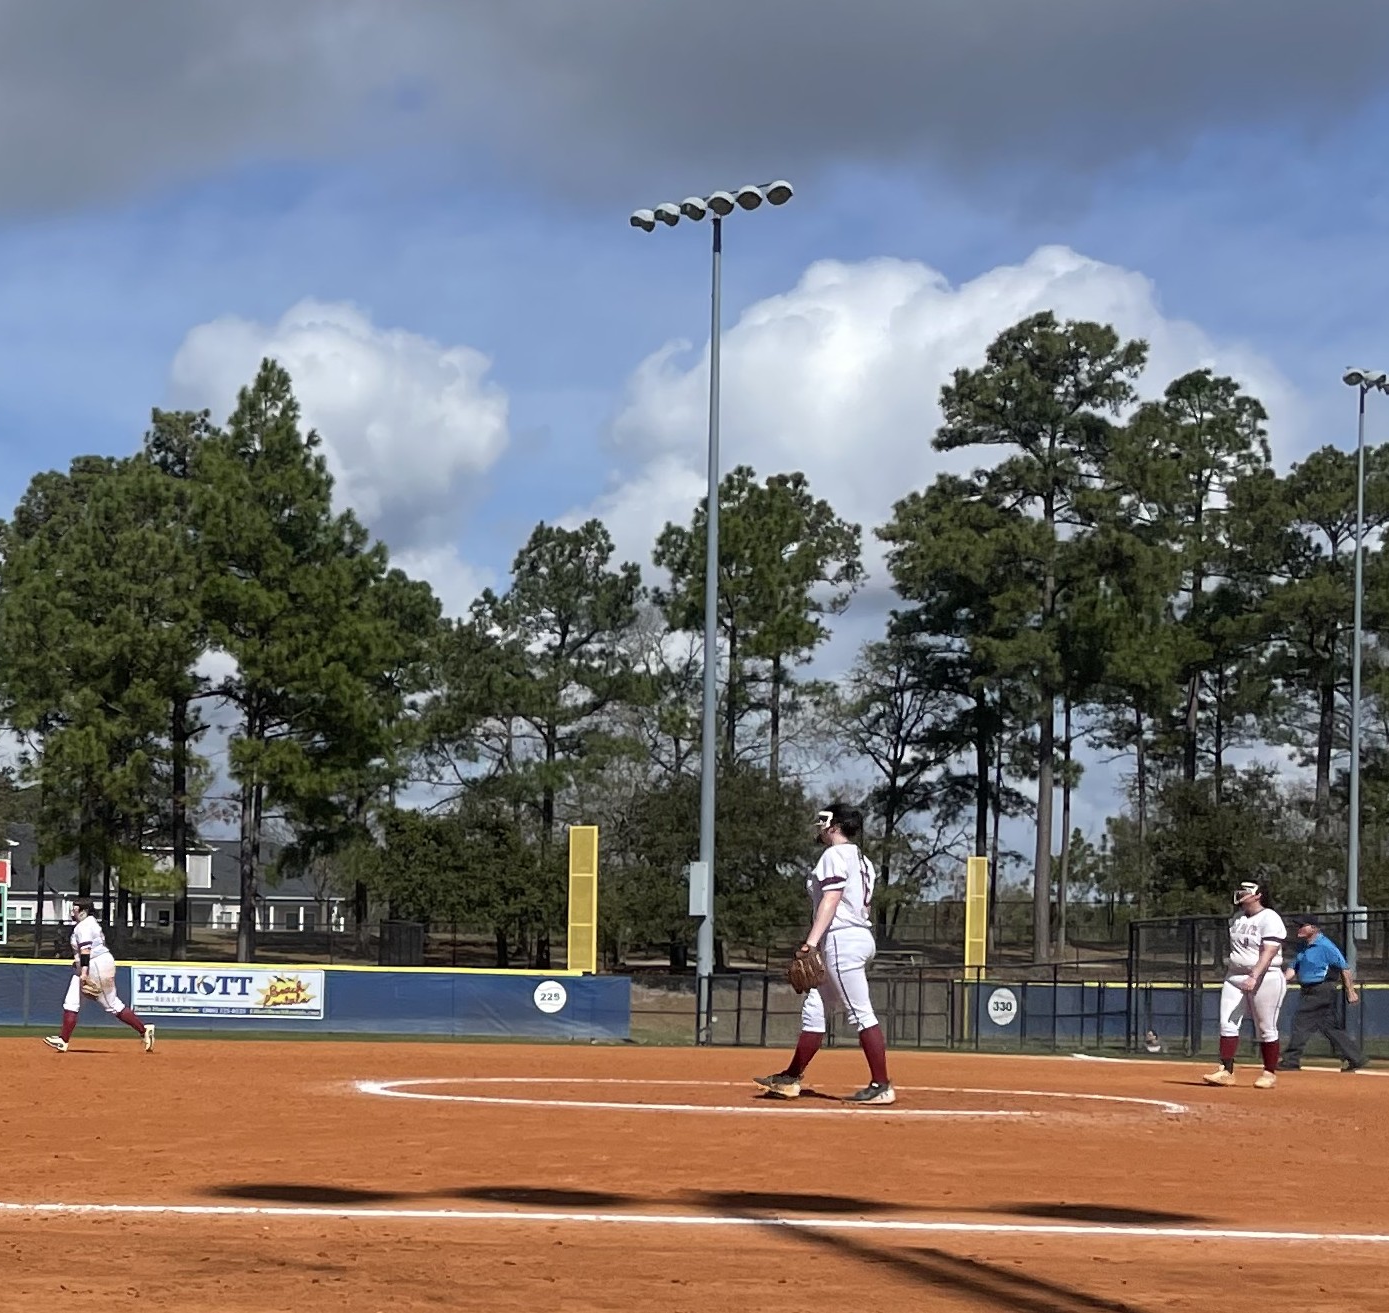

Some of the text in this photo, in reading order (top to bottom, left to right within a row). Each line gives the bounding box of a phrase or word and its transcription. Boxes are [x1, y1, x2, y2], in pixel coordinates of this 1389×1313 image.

[137, 973, 253, 996] ELLIOTT
[270, 981, 305, 997] Beach
[993, 1001, 1012, 1011] 330
